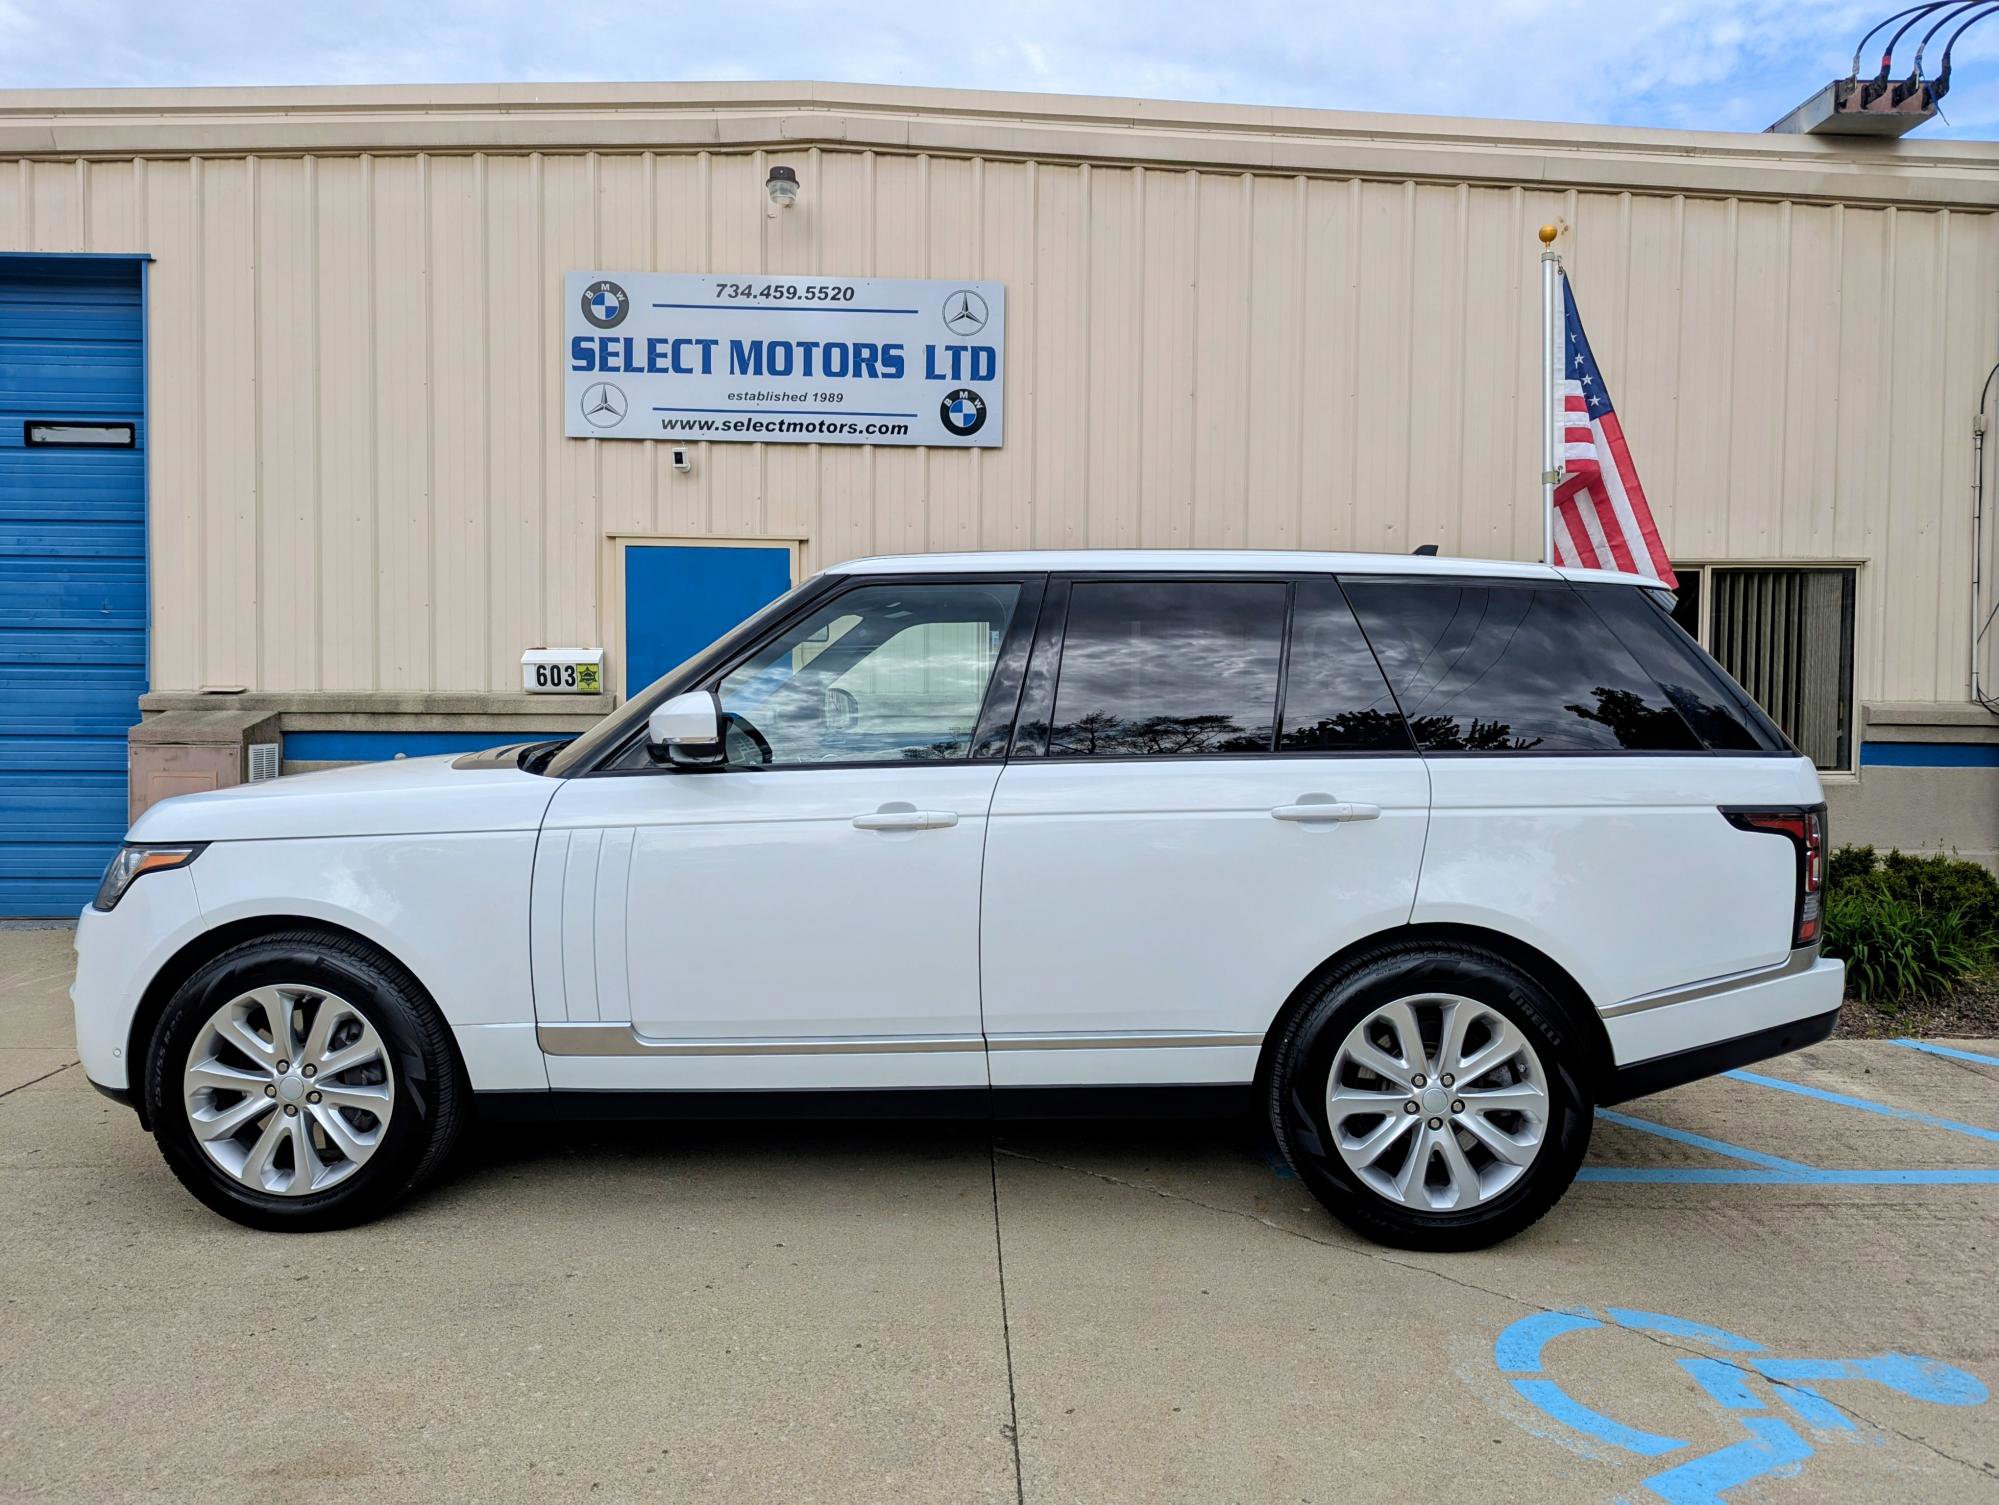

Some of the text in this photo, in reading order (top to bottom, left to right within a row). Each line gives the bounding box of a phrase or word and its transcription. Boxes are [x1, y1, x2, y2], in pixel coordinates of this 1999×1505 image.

[585, 283, 626, 301] BMW
[715, 283, 855, 301] 734.459.5520
[571, 336, 996, 381] SELECT MOTORS LTD
[727, 391, 844, 403] established 1989
[943, 390, 984, 409] BMW
[661, 417, 909, 436] www.selectmotors.com
[536, 664, 577, 687] 603
[1507, 991, 1561, 1046] PIRELLI
